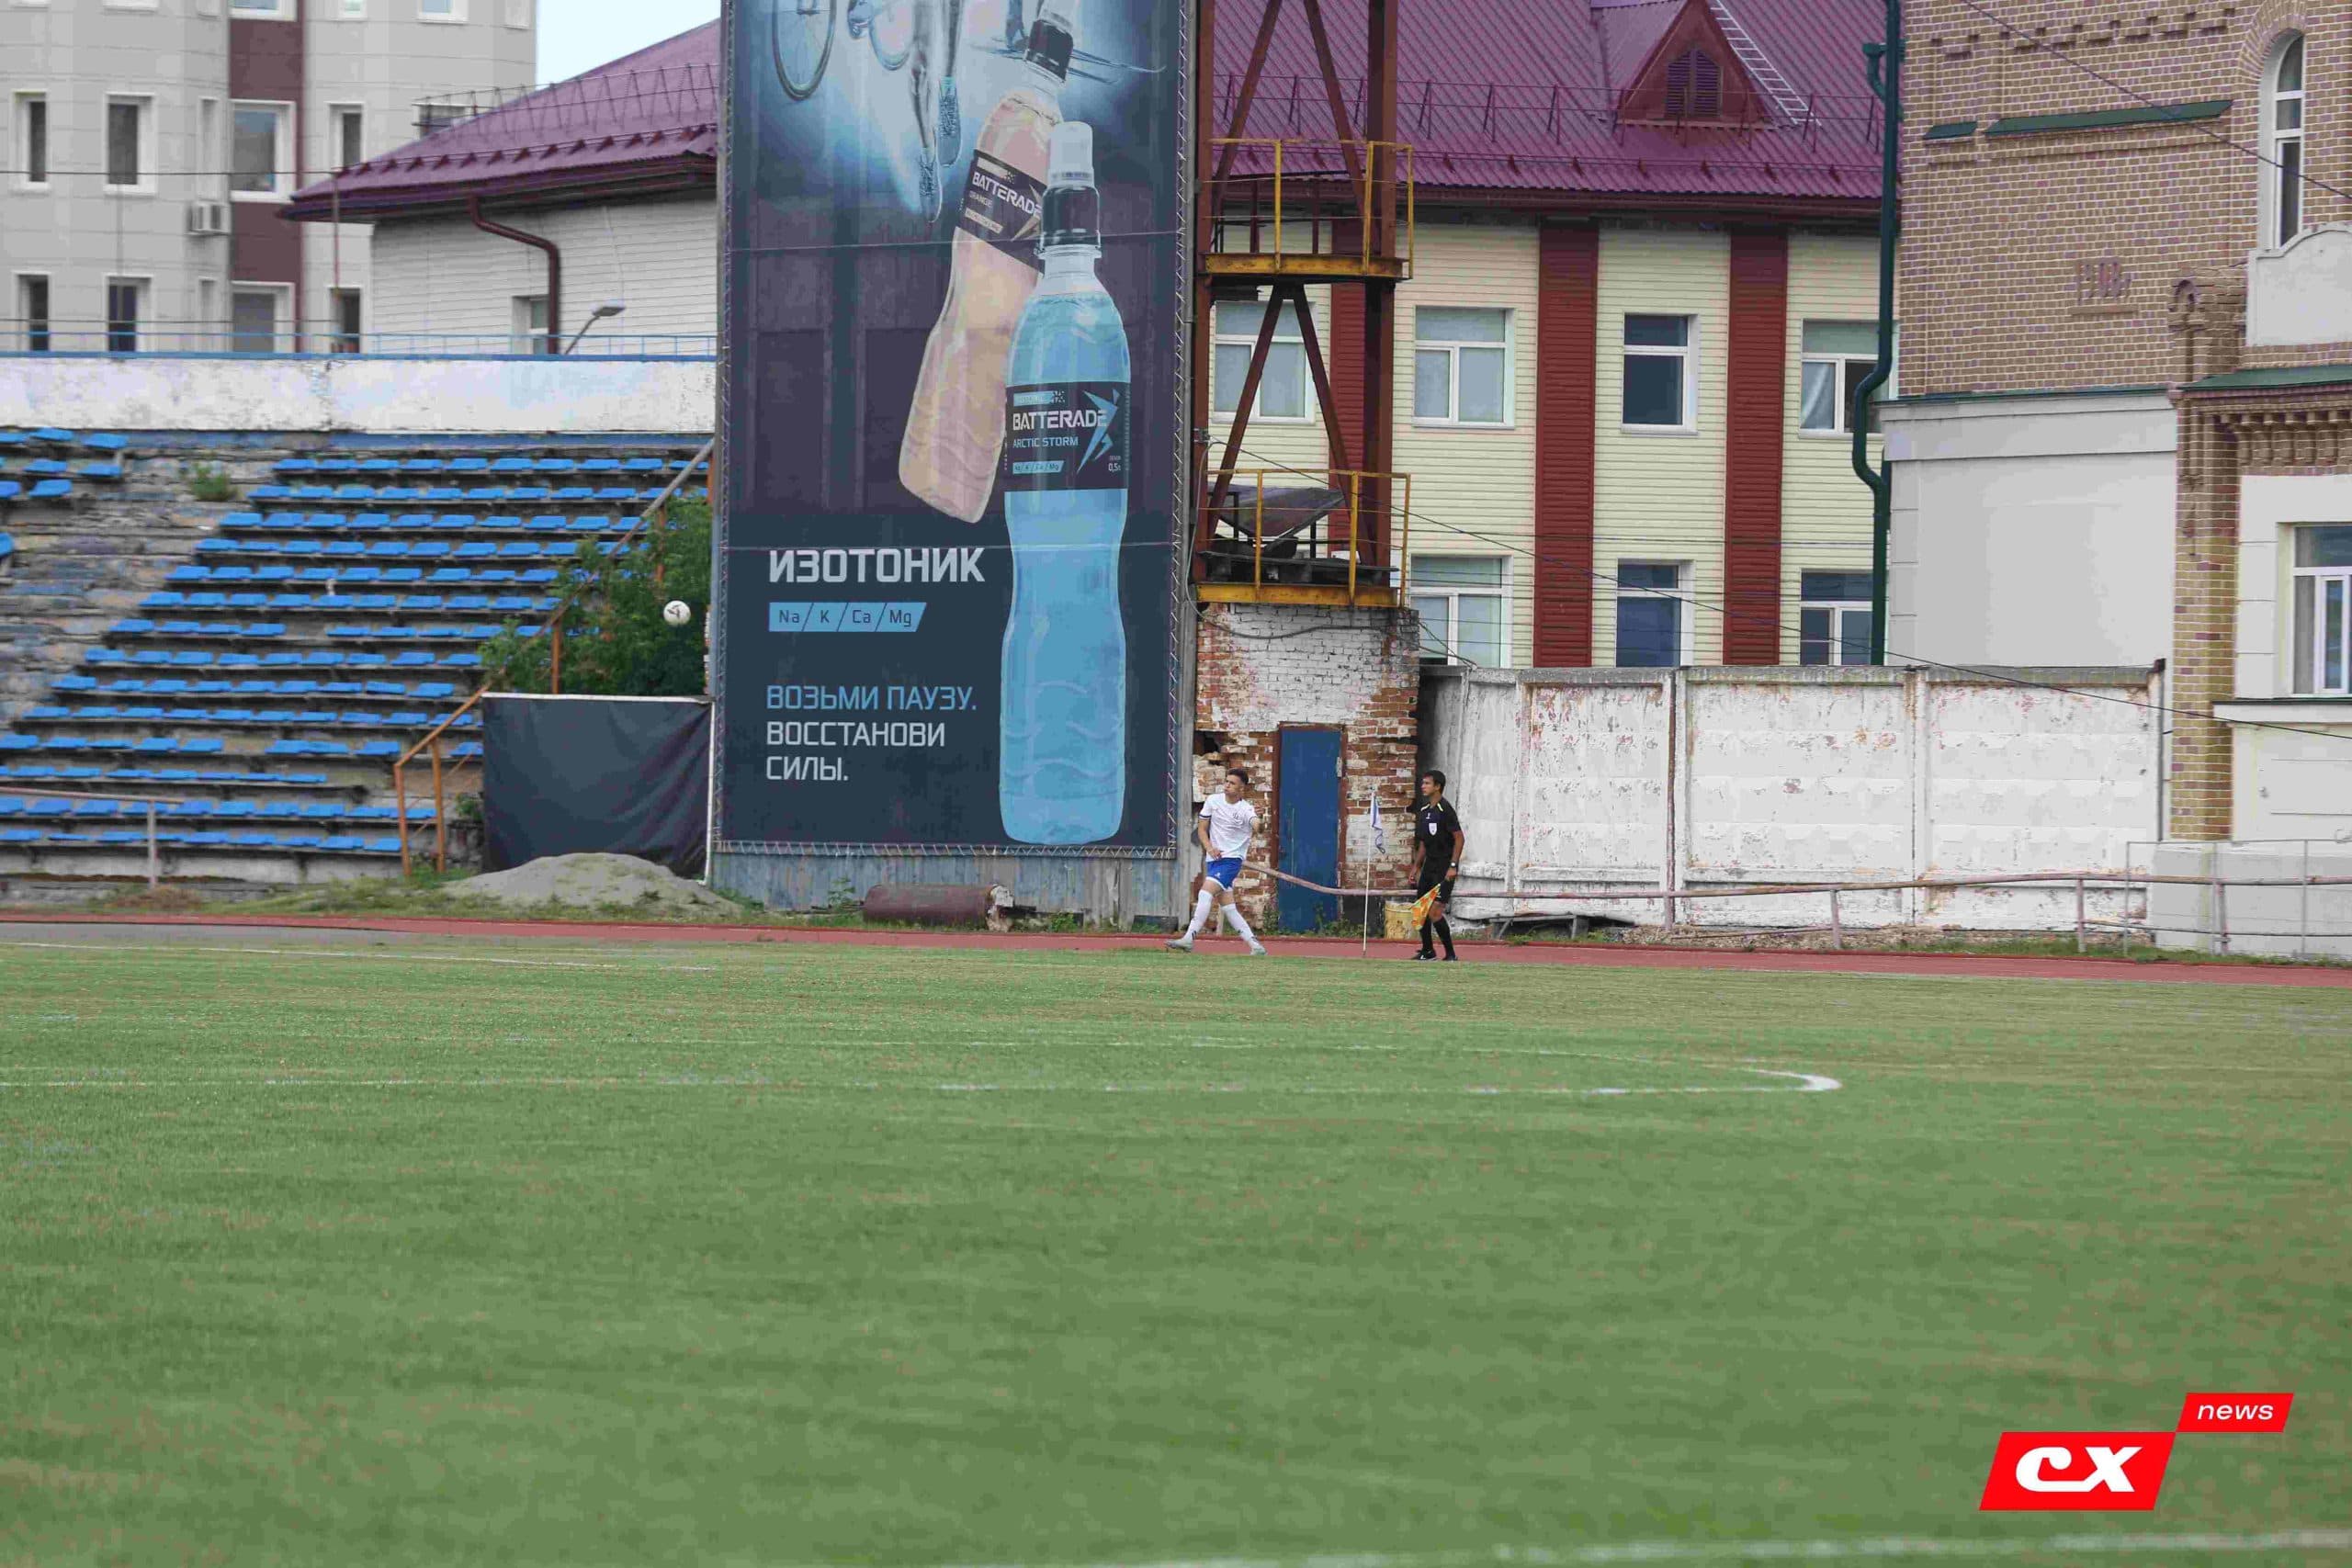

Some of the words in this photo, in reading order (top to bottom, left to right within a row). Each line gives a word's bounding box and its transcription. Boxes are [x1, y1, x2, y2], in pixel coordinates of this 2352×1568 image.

[1012, 410, 1108, 431] BATTERADE
[1013, 437, 1040, 448] ARCTIC
[1042, 436, 1080, 447] STORM
[769, 547, 986, 582] ИЗОТОНИК
[779, 610, 799, 623] Na
[820, 610, 830, 623] K
[852, 610, 871, 623] Ca
[889, 610, 911, 627] Mg
[766, 685, 878, 710] ВОЗЬМИ
[887, 685, 978, 710] ПАУЗУ.
[766, 721, 945, 747] ВОССТАНОВИ
[766, 756, 849, 781] СИЛЫ.
